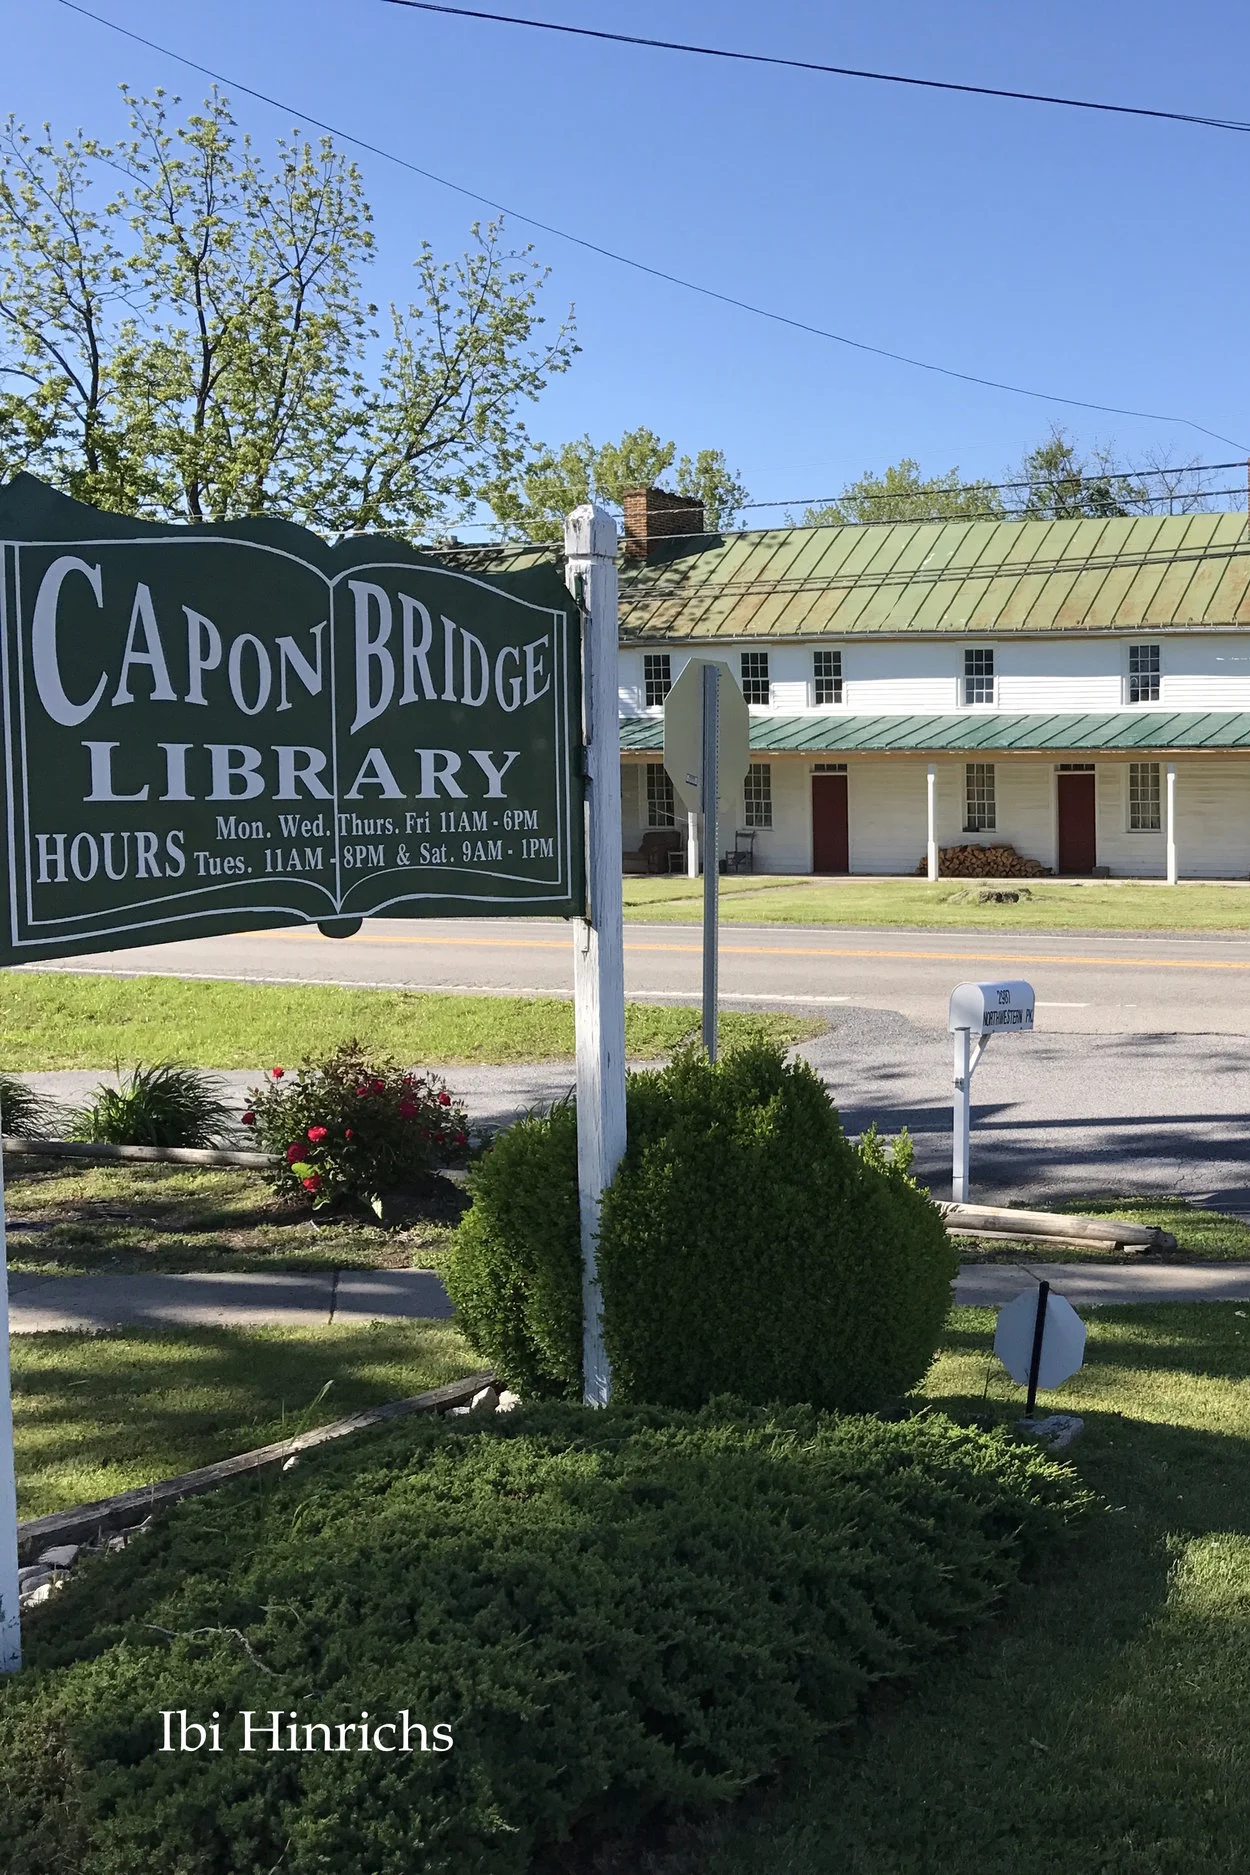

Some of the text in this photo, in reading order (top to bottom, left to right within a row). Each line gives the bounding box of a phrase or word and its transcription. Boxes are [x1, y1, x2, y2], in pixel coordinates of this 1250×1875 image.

[32, 555, 551, 735] CAPON BRIDGE
[81, 741, 521, 801] LIBRARY
[215, 815, 271, 840] Mon.
[278, 813, 331, 838] Wed.
[337, 812, 399, 836] Thurs.
[405, 811, 430, 834] Fri
[440, 810, 488, 833] 11AM
[503, 809, 539, 831] 6PM
[34, 830, 186, 884] HOURS
[193, 851, 252, 876] Tues.
[264, 846, 323, 872] 11AM
[343, 844, 385, 868] 8PM
[396, 843, 411, 866] &
[419, 842, 455, 864] Sat.
[462, 839, 503, 862] 9AM
[521, 837, 554, 859] 1PM
[983, 1009, 1023, 1026] NORTHWESTERN
